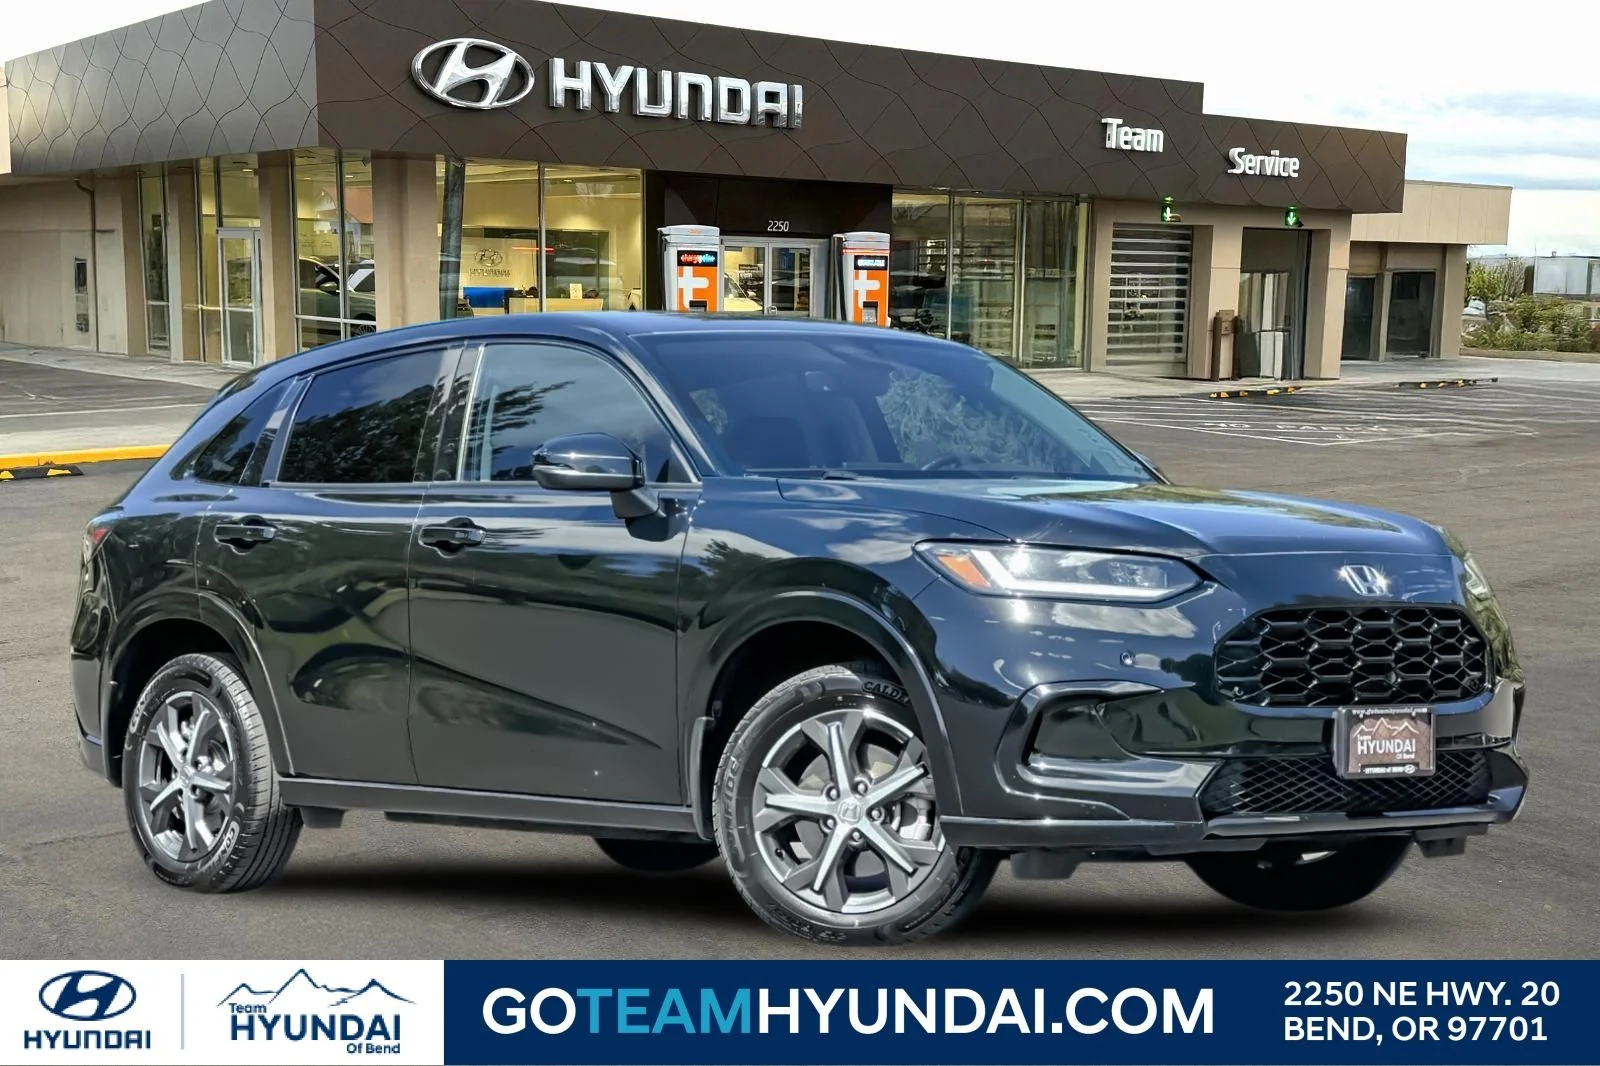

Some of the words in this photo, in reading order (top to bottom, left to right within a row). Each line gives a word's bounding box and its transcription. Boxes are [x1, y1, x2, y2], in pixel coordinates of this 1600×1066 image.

[549, 57, 803, 129] HYUNDAI
[1101, 117, 1165, 153] Team
[1227, 147, 1300, 178] Service
[767, 220, 790, 232] 2250
[1357, 738, 1416, 755] HYUNDAI
